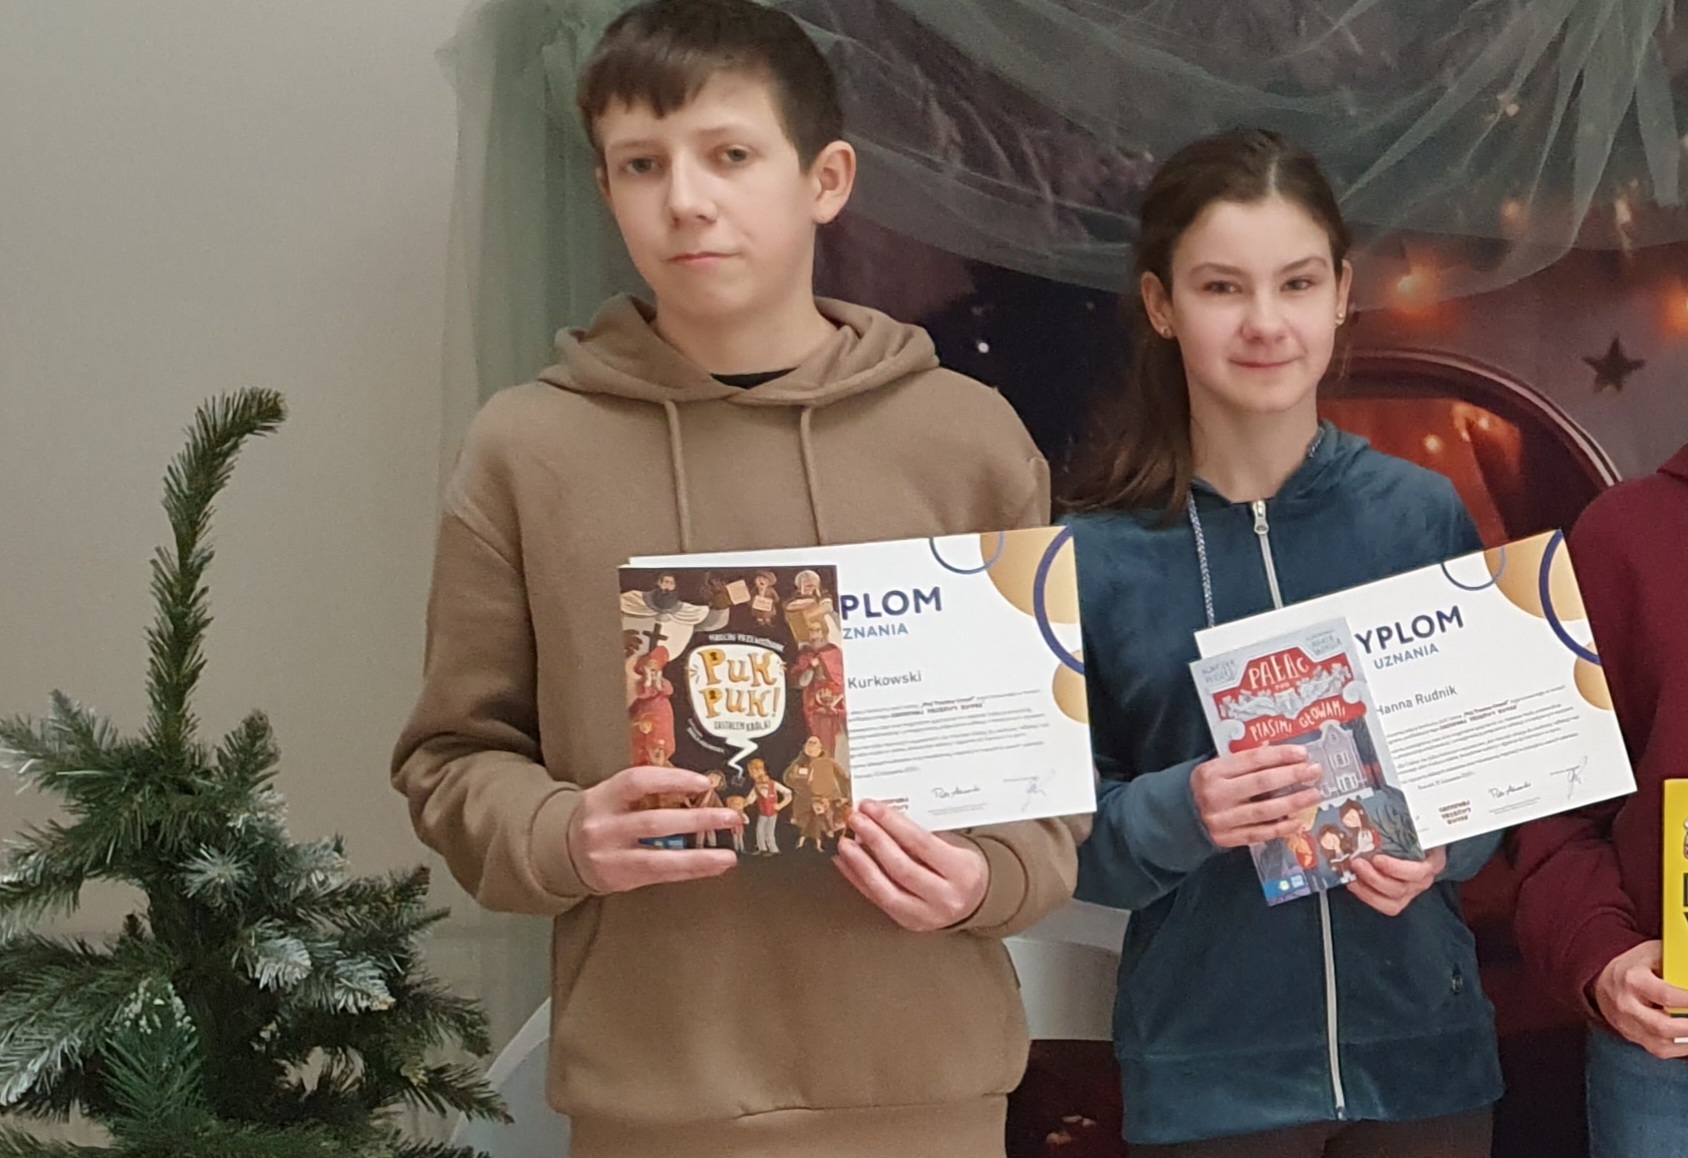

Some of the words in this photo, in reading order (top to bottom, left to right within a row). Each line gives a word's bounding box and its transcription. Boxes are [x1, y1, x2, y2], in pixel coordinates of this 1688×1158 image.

[840, 586, 942, 620] PLOM
[843, 623, 909, 640] ZNANIA
[1354, 605, 1464, 654] YPLOM
[1373, 643, 1440, 670] UZNANIA
[847, 670, 922, 689] Kurkowski
[1249, 653, 1309, 690] PAŁAC
[1415, 685, 1458, 705] Rudnik
